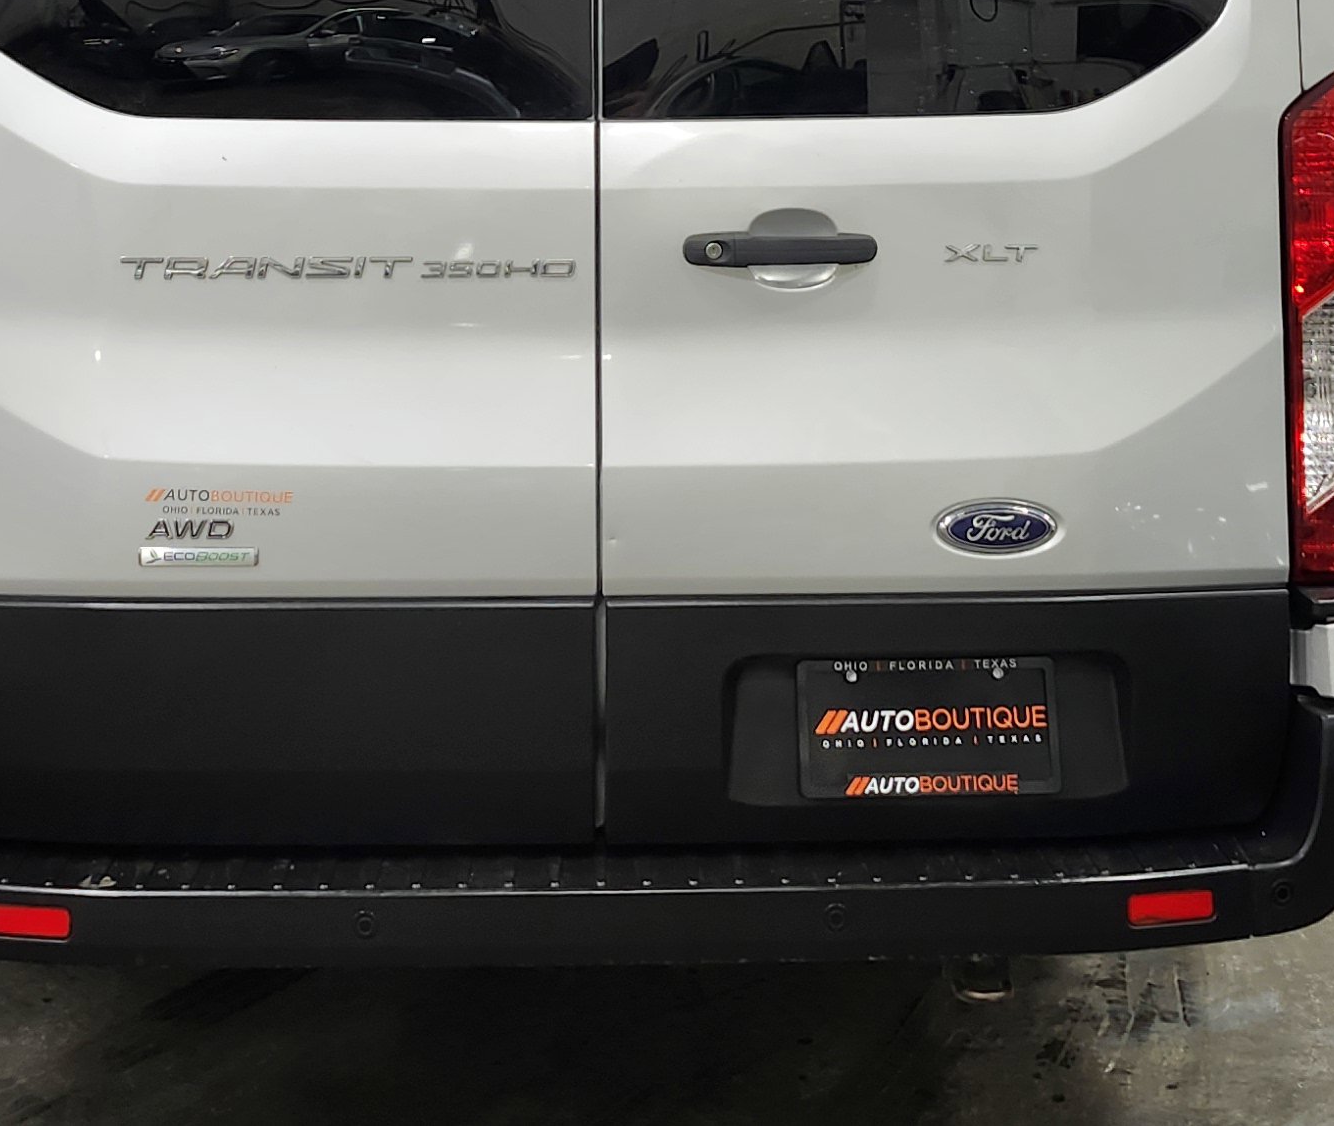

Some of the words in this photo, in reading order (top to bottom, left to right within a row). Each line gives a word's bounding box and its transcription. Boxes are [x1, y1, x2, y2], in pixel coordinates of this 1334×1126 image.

[944, 243, 1039, 263] XLT
[120, 254, 413, 280] TRANSIT
[420, 258, 576, 279] 350HD
[163, 488, 294, 504] AUTOBOUTIQUE
[162, 506, 188, 515] OHIO
[196, 506, 239, 516] FLORIDA
[247, 507, 281, 516] TEXAS
[145, 518, 235, 540] AWD
[966, 514, 1031, 542] Ford
[833, 661, 868, 672] OHIO
[889, 660, 954, 671] FLORIDA
[974, 658, 1018, 670] TEXAS
[841, 705, 1047, 733] AUTOBOUTIQUE
[822, 738, 865, 749] OHIO
[885, 736, 963, 747] FLORIDA
[986, 734, 1043, 745] TEXAS
[864, 774, 1019, 795] AUTOBOUTIQUE
